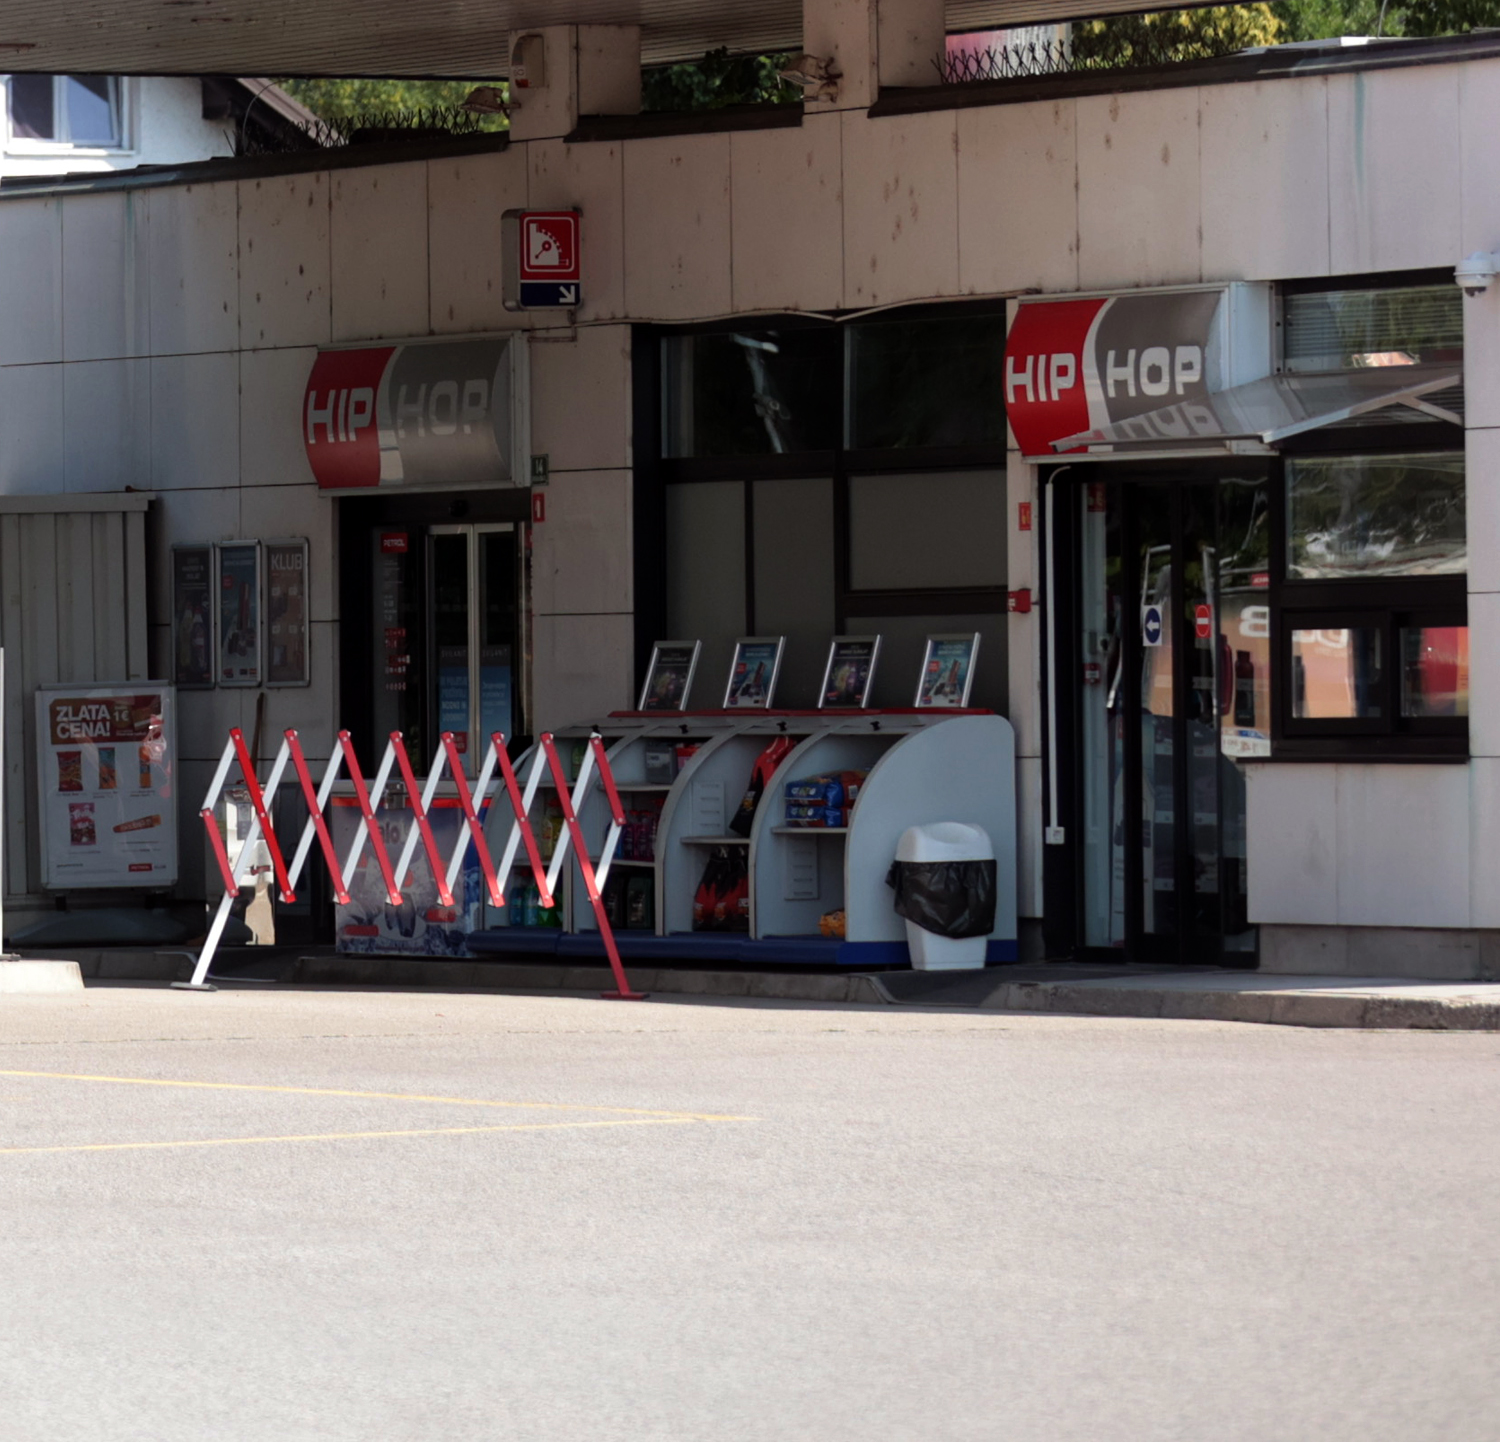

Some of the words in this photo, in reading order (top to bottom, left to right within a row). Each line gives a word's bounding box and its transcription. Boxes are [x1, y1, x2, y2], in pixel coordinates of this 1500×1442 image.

[1005, 352, 1076, 403] HIP
[1106, 344, 1203, 398] HOP
[306, 386, 374, 444] HIP
[399, 378, 489, 439] HOP
[271, 553, 303, 570] KLUB
[56, 703, 111, 722] ZLATA
[56, 721, 111, 739] CENA!
